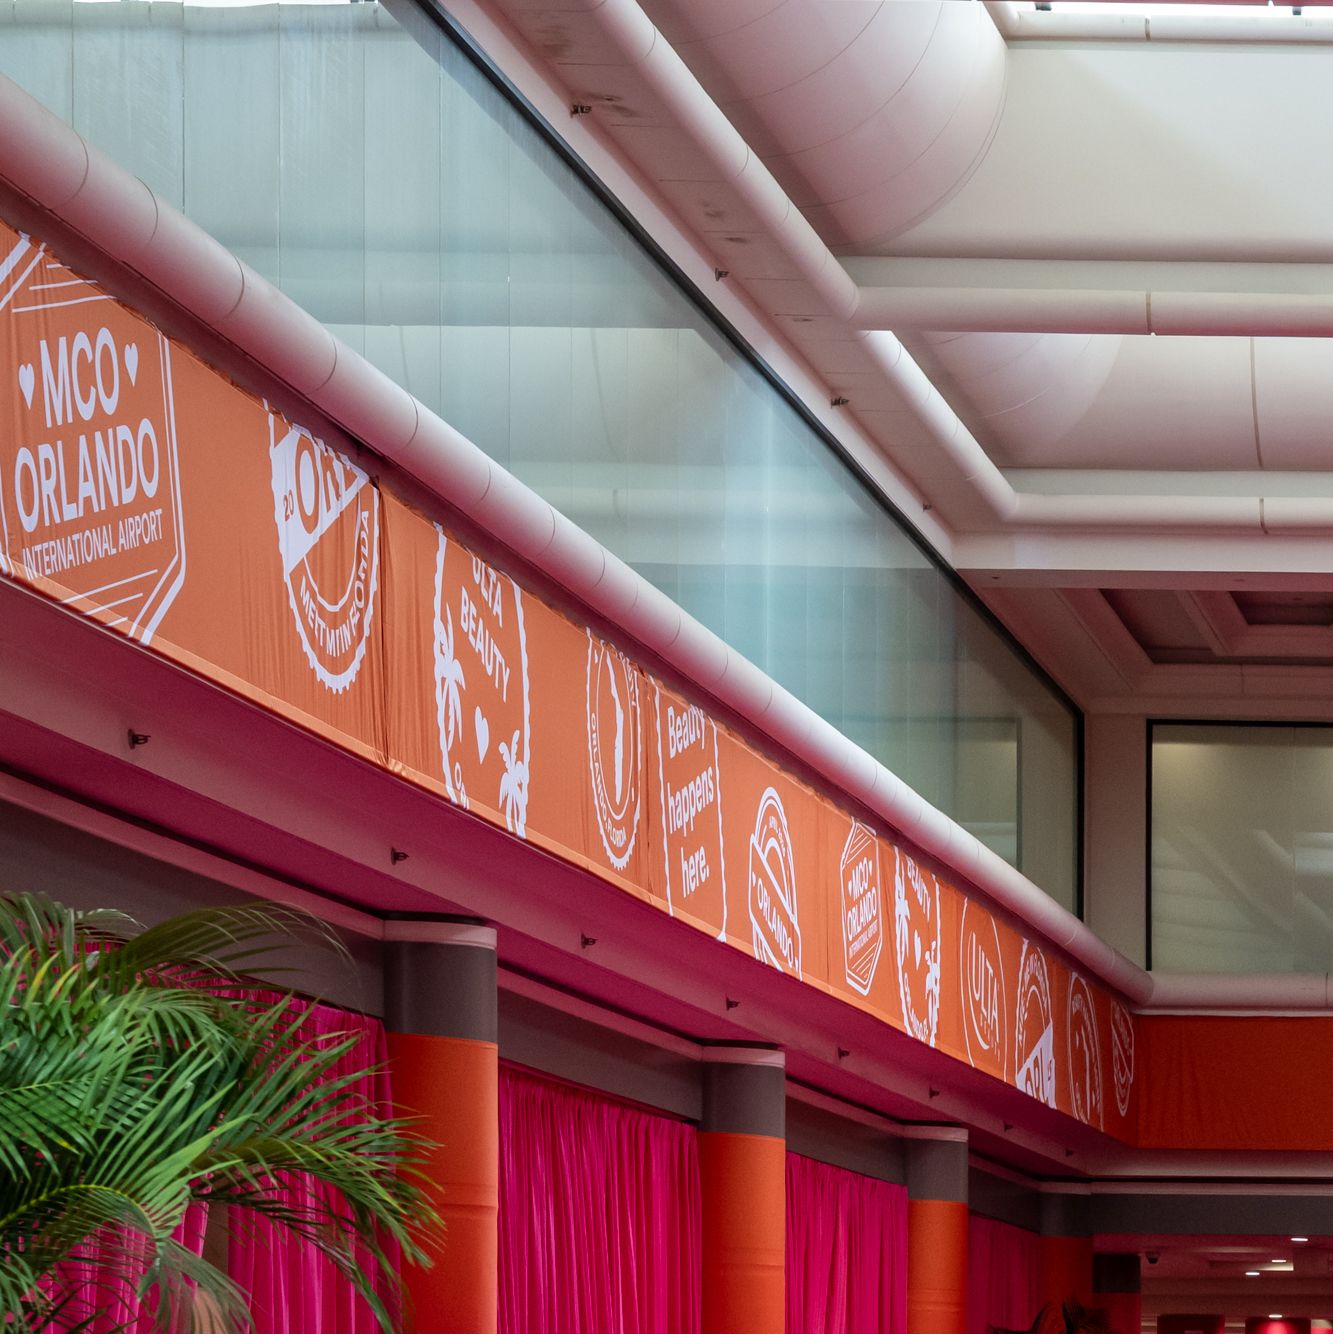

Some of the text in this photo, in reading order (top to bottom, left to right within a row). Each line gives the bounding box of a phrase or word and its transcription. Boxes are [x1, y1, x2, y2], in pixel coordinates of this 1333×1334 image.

[39, 326, 121, 429] MCO
[14, 417, 160, 533] ORLANDO
[22, 508, 163, 582] INTERNATIONAL AIRPORT
[461, 585, 510, 703] BEAUTY
[667, 703, 706, 759] Beauty
[667, 766, 714, 837] happens
[680, 845, 710, 899] here.
[852, 857, 869, 902] MCO
[757, 877, 794, 968] ORLANDO
[847, 886, 877, 942] ORLANDO
